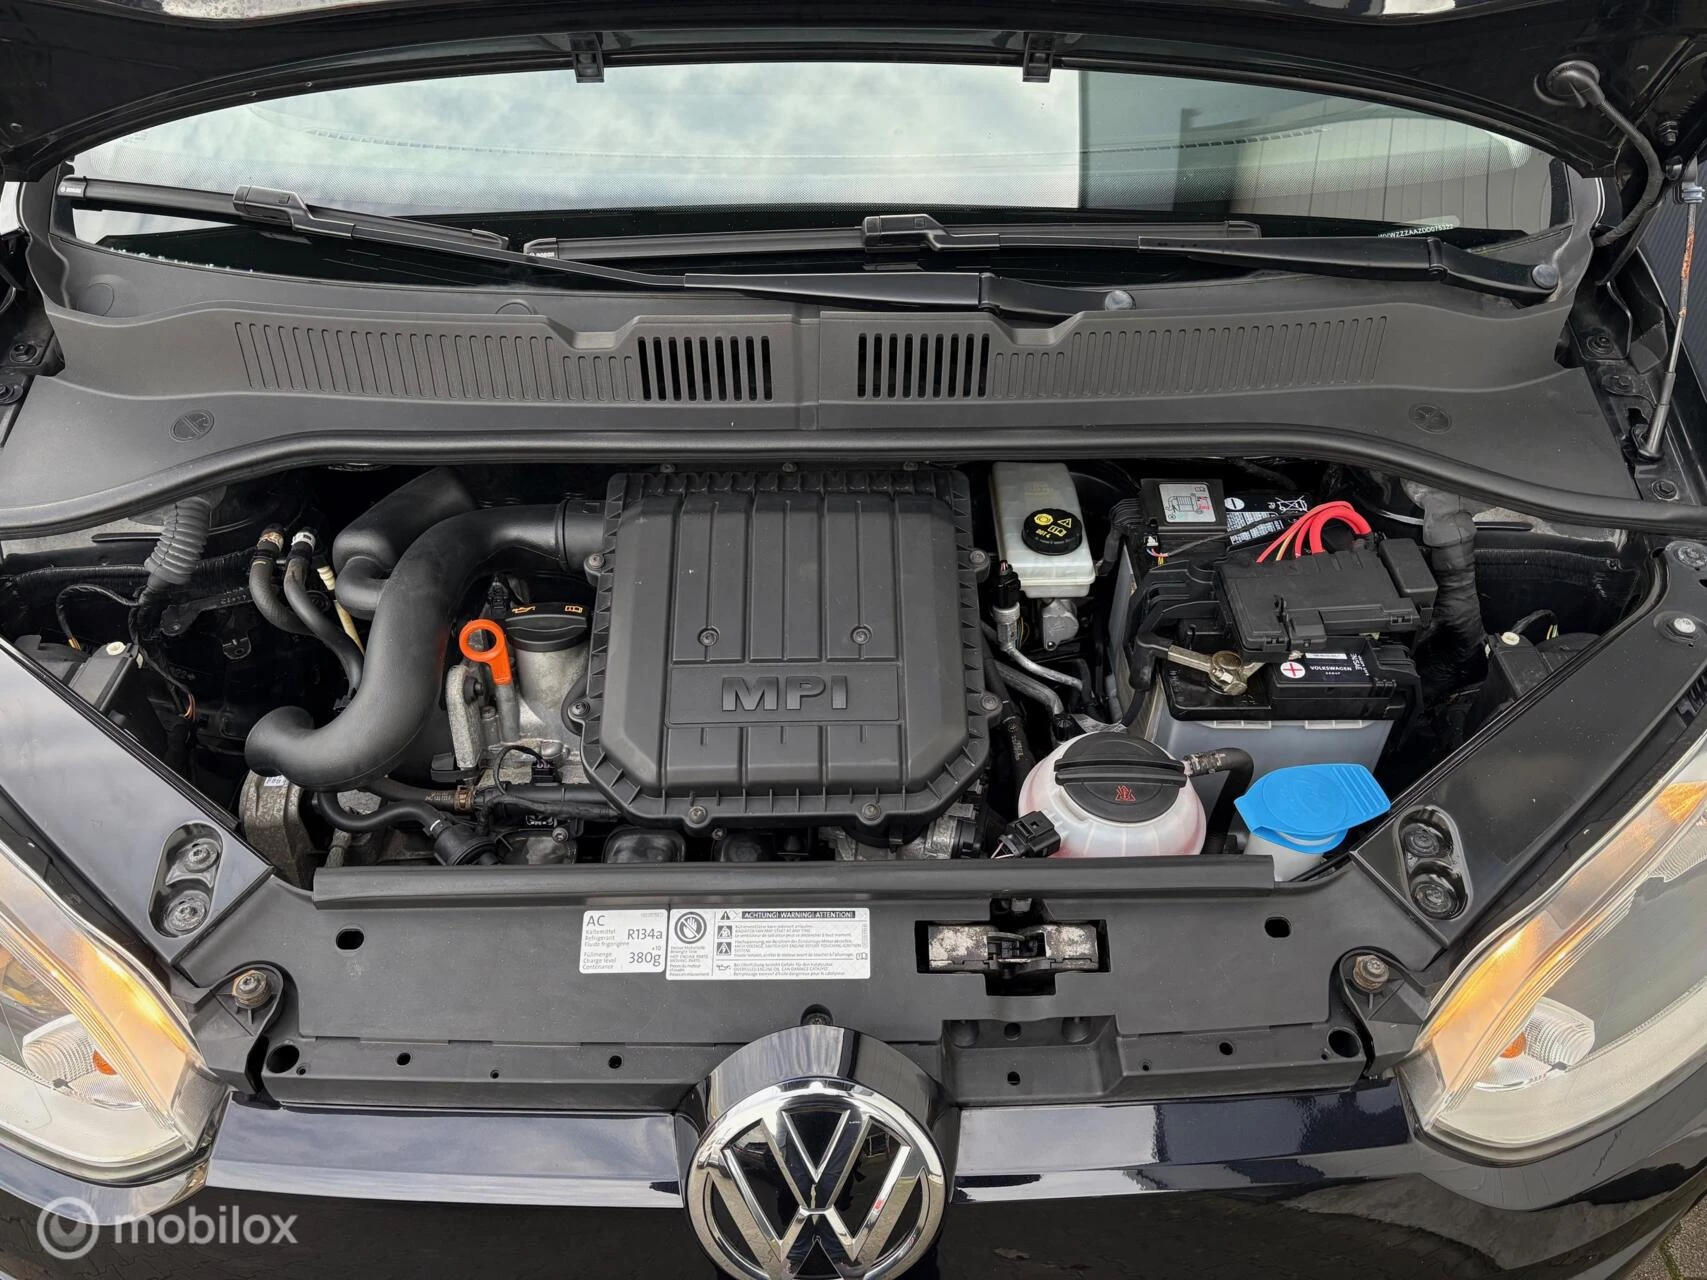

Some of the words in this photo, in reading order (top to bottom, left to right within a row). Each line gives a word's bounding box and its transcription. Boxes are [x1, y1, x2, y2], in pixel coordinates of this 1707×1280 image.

[722, 675, 848, 711] MPI
[586, 914, 606, 927] AC
[627, 928, 663, 940] R134a
[628, 951, 662, 967] 380g
